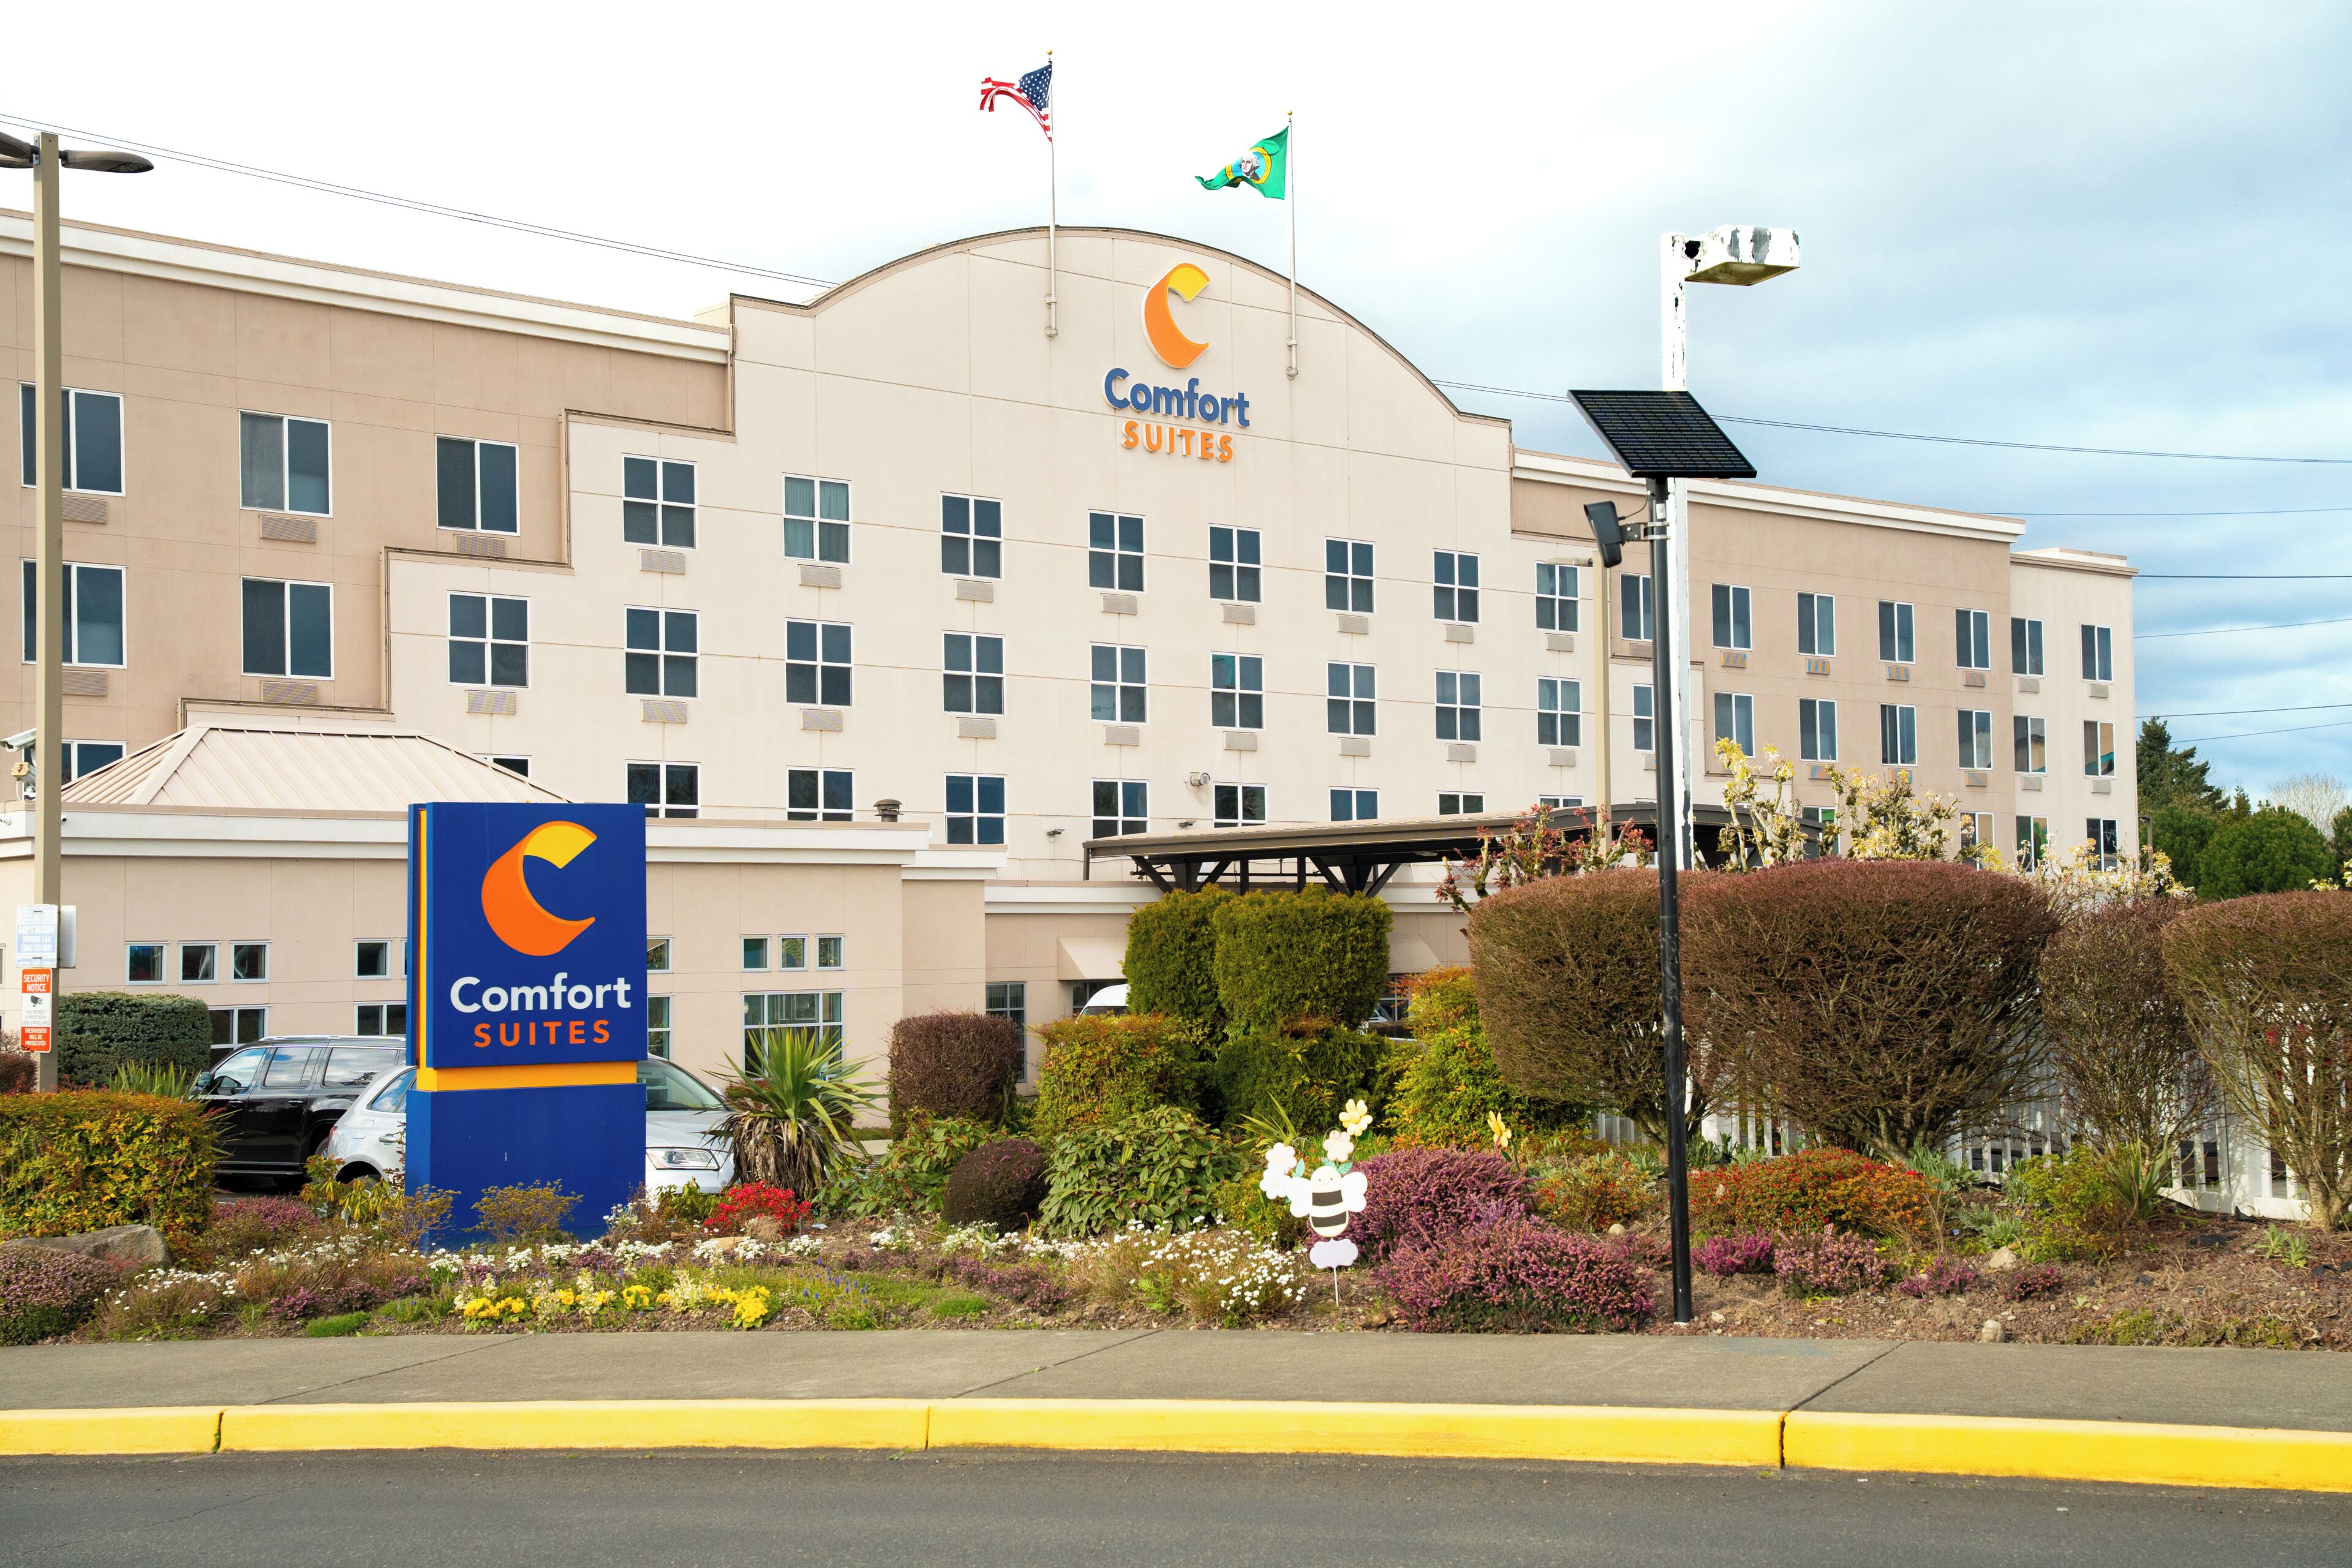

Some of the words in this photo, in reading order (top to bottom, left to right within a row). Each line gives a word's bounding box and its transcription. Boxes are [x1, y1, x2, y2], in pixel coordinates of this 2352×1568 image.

[1104, 368, 1250, 428] Comfort
[1122, 421, 1234, 462] SUITES
[23, 974, 50, 982] SECURITY
[450, 972, 631, 1013] Comfort
[474, 1019, 609, 1047] SUITES
